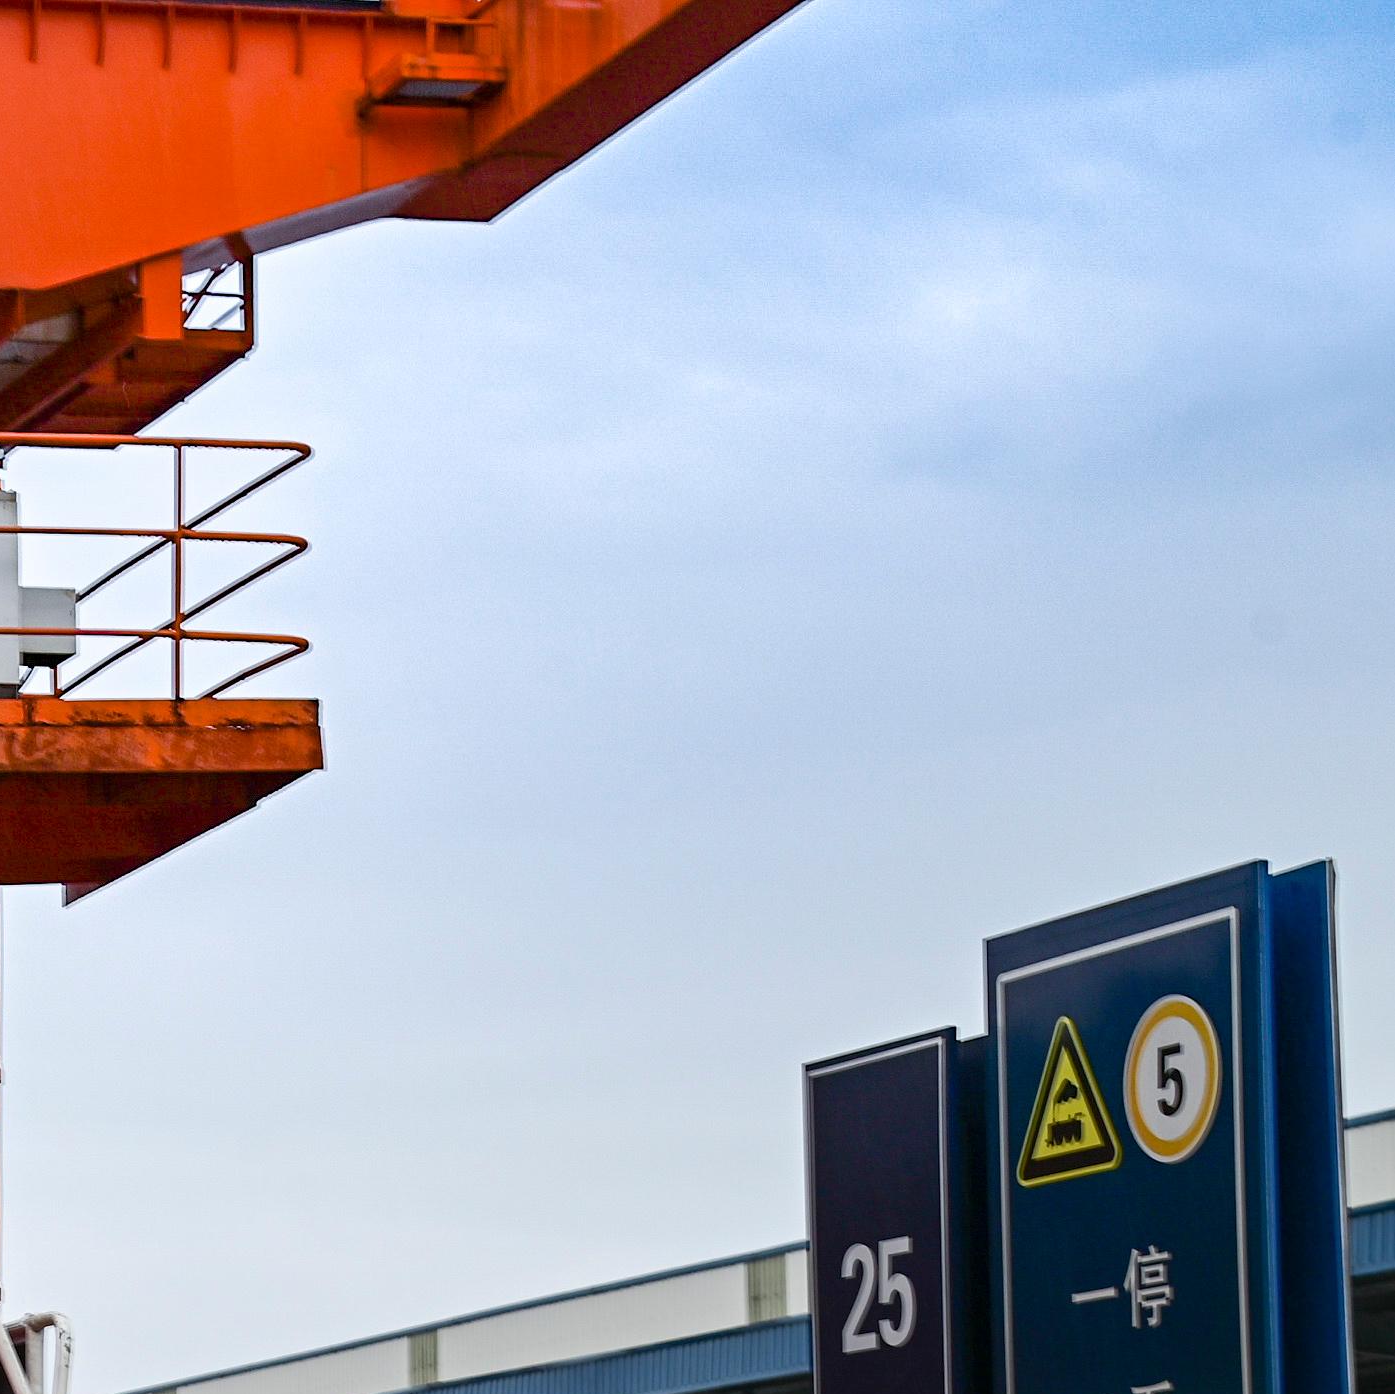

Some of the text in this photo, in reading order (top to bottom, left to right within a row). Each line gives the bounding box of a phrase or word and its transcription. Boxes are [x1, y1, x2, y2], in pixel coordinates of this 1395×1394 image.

[1156, 1042, 1184, 1117] 5
[841, 1236, 917, 1353] 25
[1071, 1245, 1174, 1329] 一停
